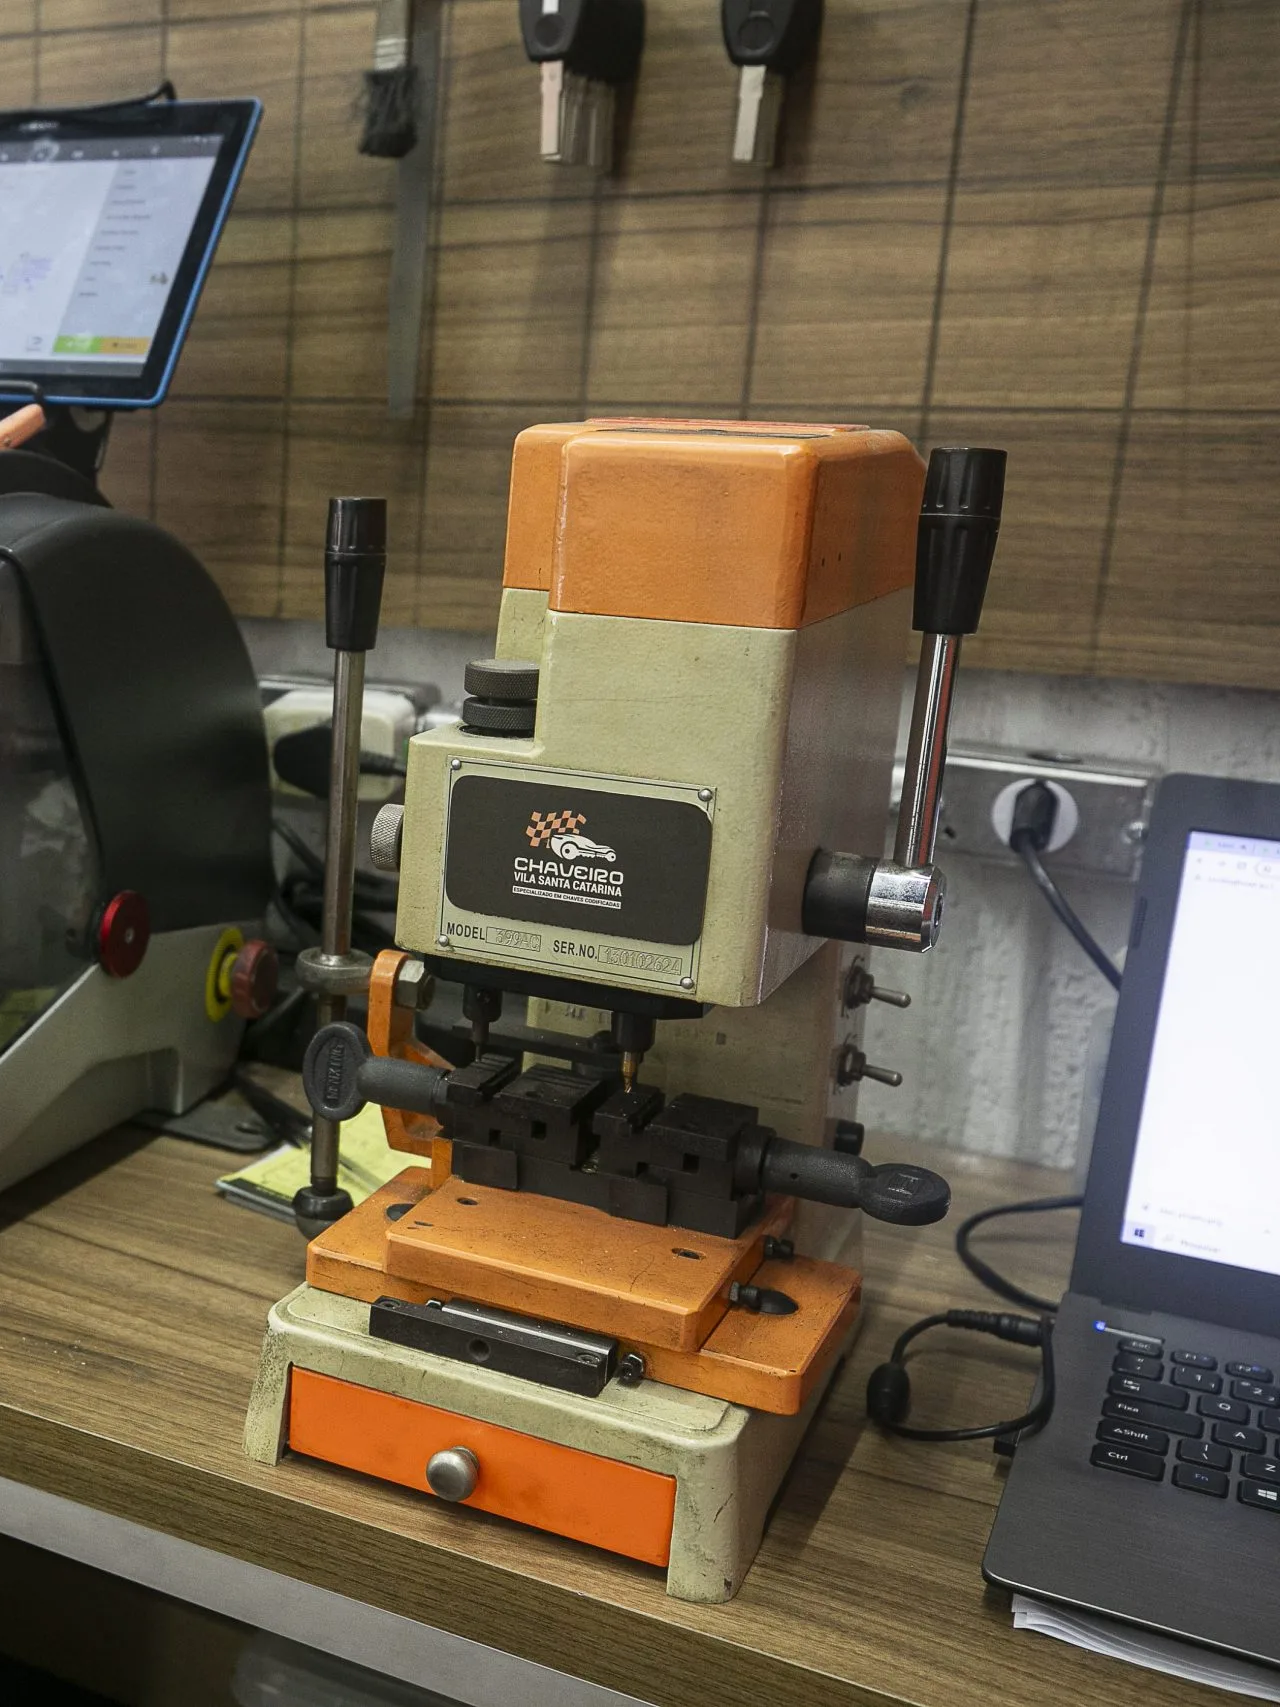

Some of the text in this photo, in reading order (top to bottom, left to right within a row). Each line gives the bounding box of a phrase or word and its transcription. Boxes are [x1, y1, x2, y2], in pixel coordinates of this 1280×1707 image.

[514, 857, 624, 885] CHAVEIRO
[514, 871, 622, 897] VILA SANTA CATARINA
[513, 886, 553, 898] ESPECIALIZADO
[562, 895, 584, 903] CHAVES
[584, 897, 620, 908] CODIFICADAS
[446, 922, 485, 940] MODEL
[553, 940, 598, 960] SER.NO.
[1124, 1429, 1149, 1441] Shift
[1235, 1431, 1246, 1439] A
[1108, 1451, 1129, 1461] Ctrl
[1265, 1463, 1276, 1473] Z
[1195, 1473, 1209, 1482] Fn
